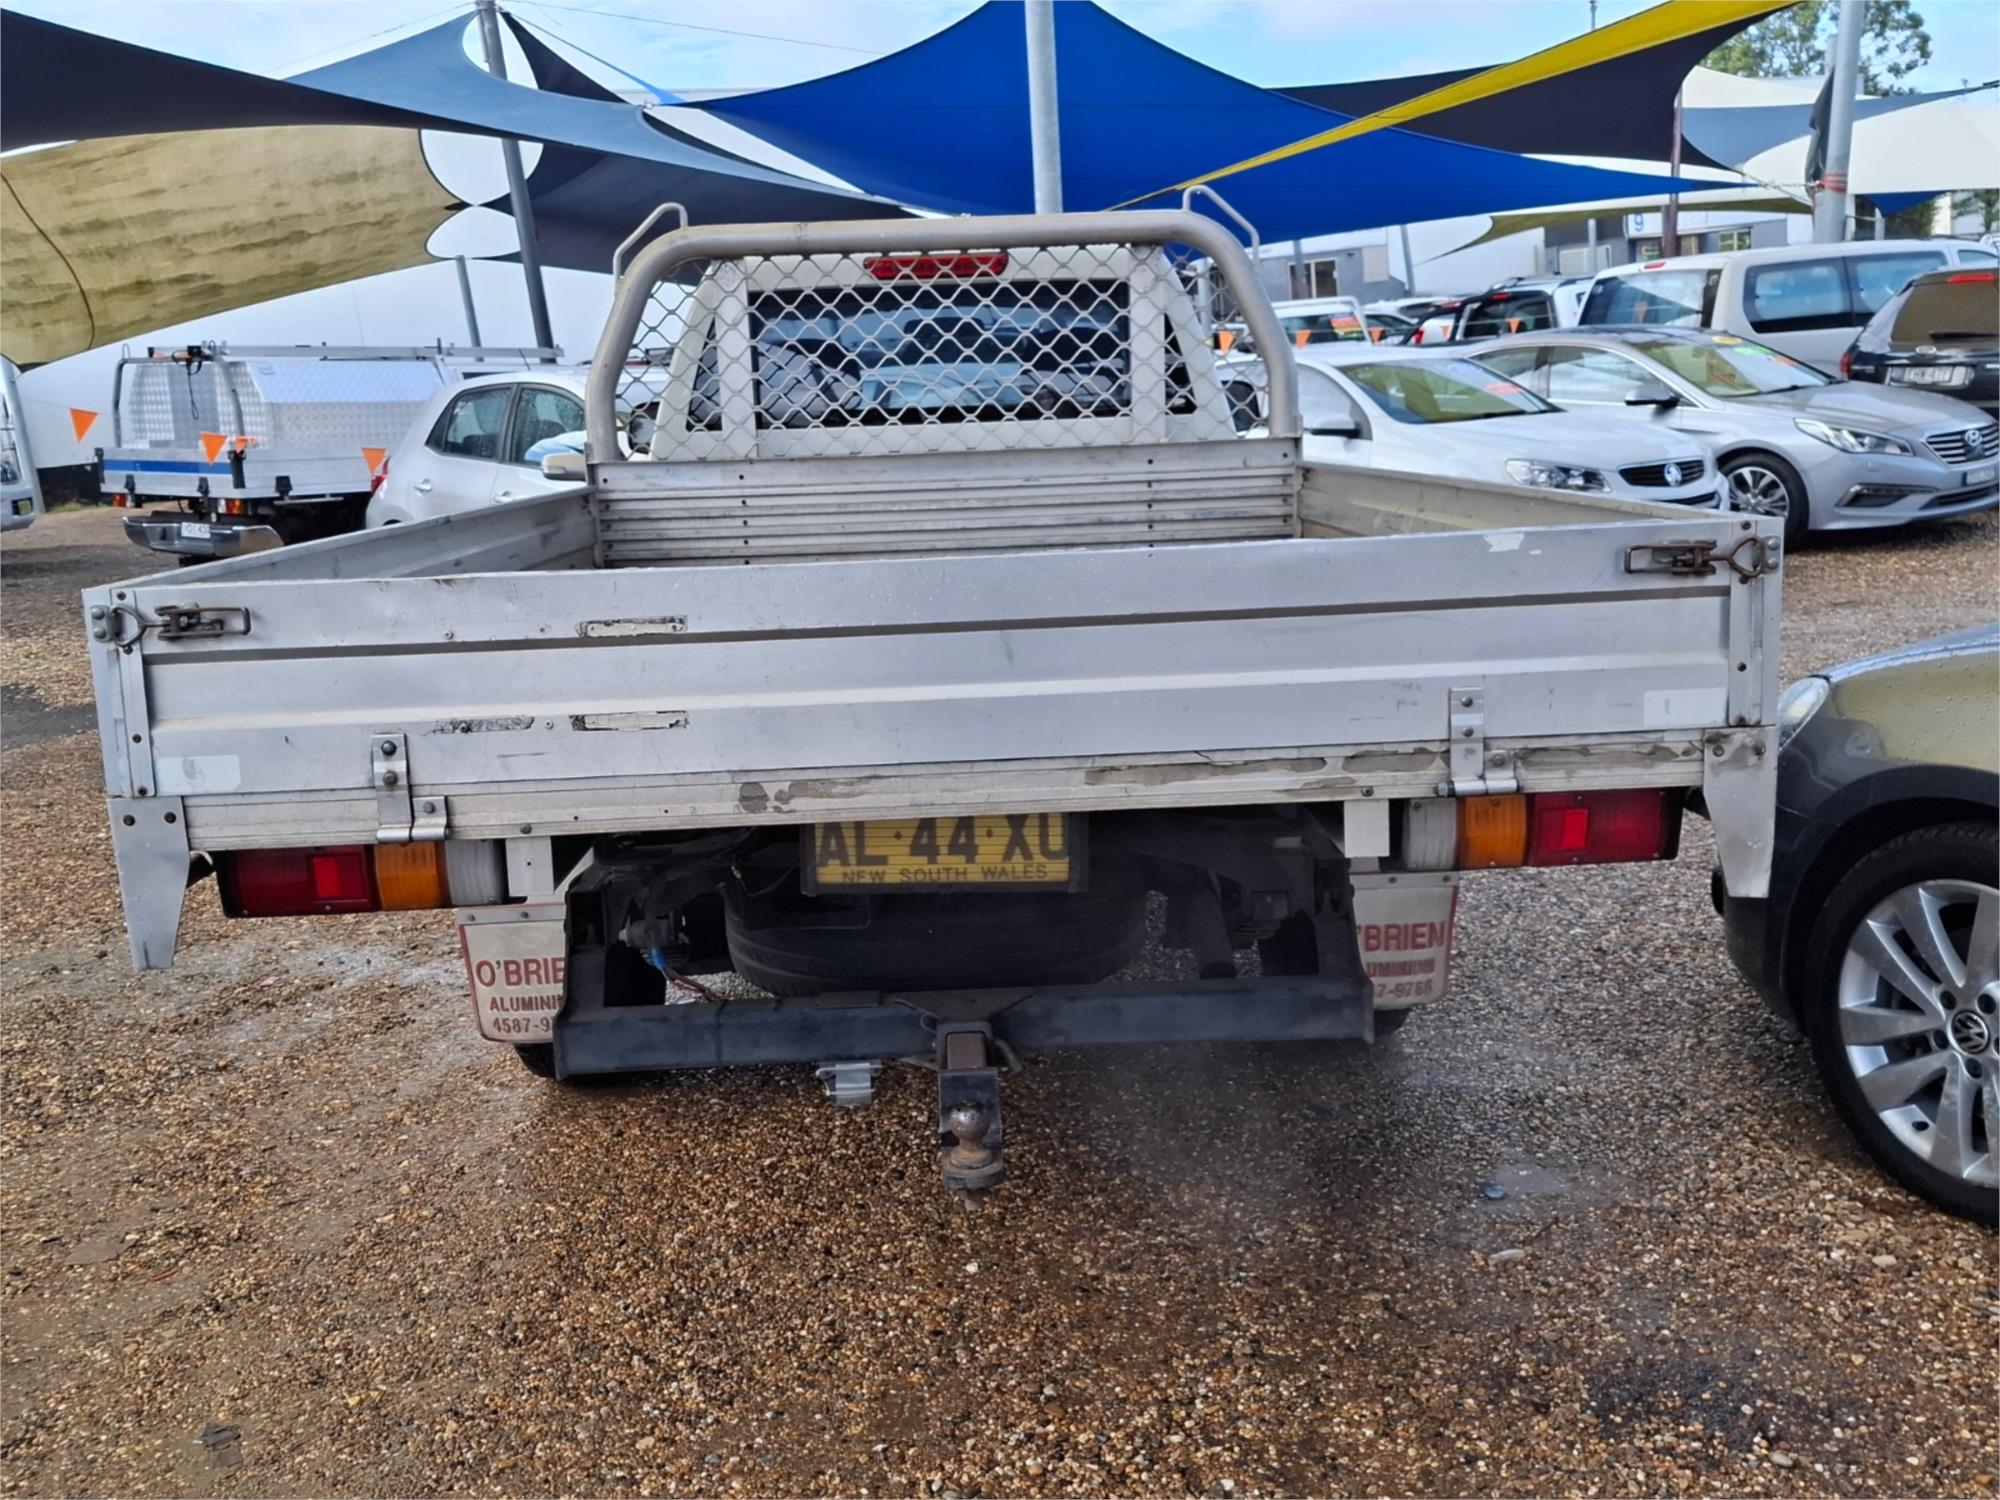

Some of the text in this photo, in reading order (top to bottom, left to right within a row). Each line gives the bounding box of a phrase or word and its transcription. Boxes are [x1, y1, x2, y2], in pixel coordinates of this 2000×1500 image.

[909, 816, 979, 864] 44
[843, 864, 1048, 883] NEW SOUTH WALES
[492, 1016, 554, 1033] 4587-9
